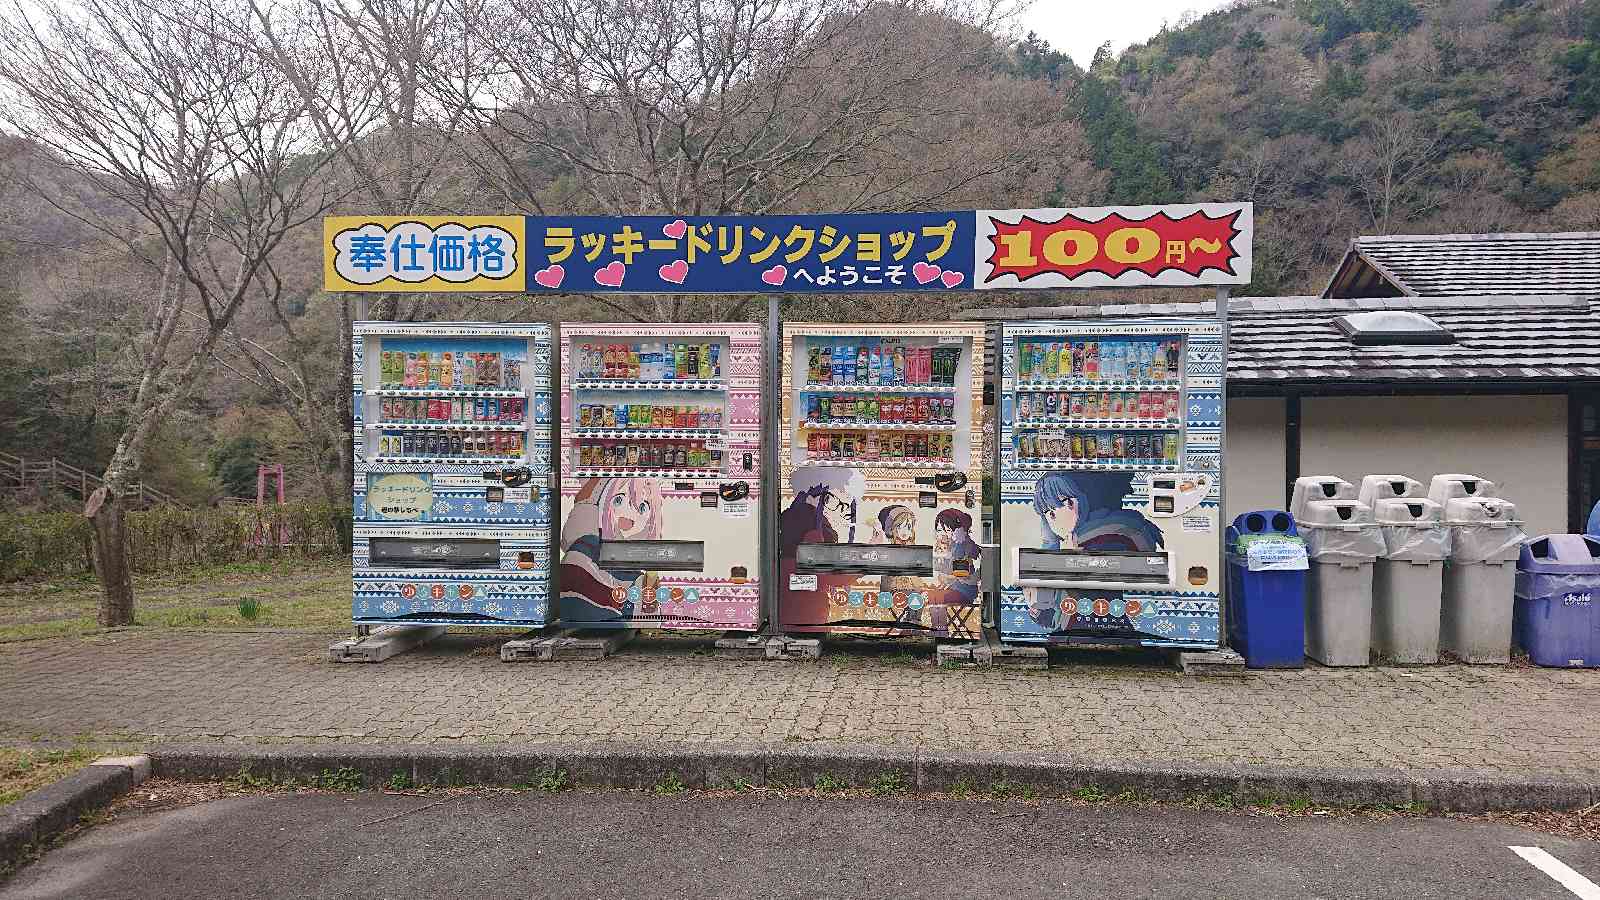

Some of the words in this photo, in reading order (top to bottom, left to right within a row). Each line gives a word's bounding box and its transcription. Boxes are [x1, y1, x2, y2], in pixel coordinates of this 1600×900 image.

[349, 233, 506, 273] 奉仕価格
[543, 220, 956, 265] ラッキードリンクショップ
[793, 265, 907, 286] へようこそ
